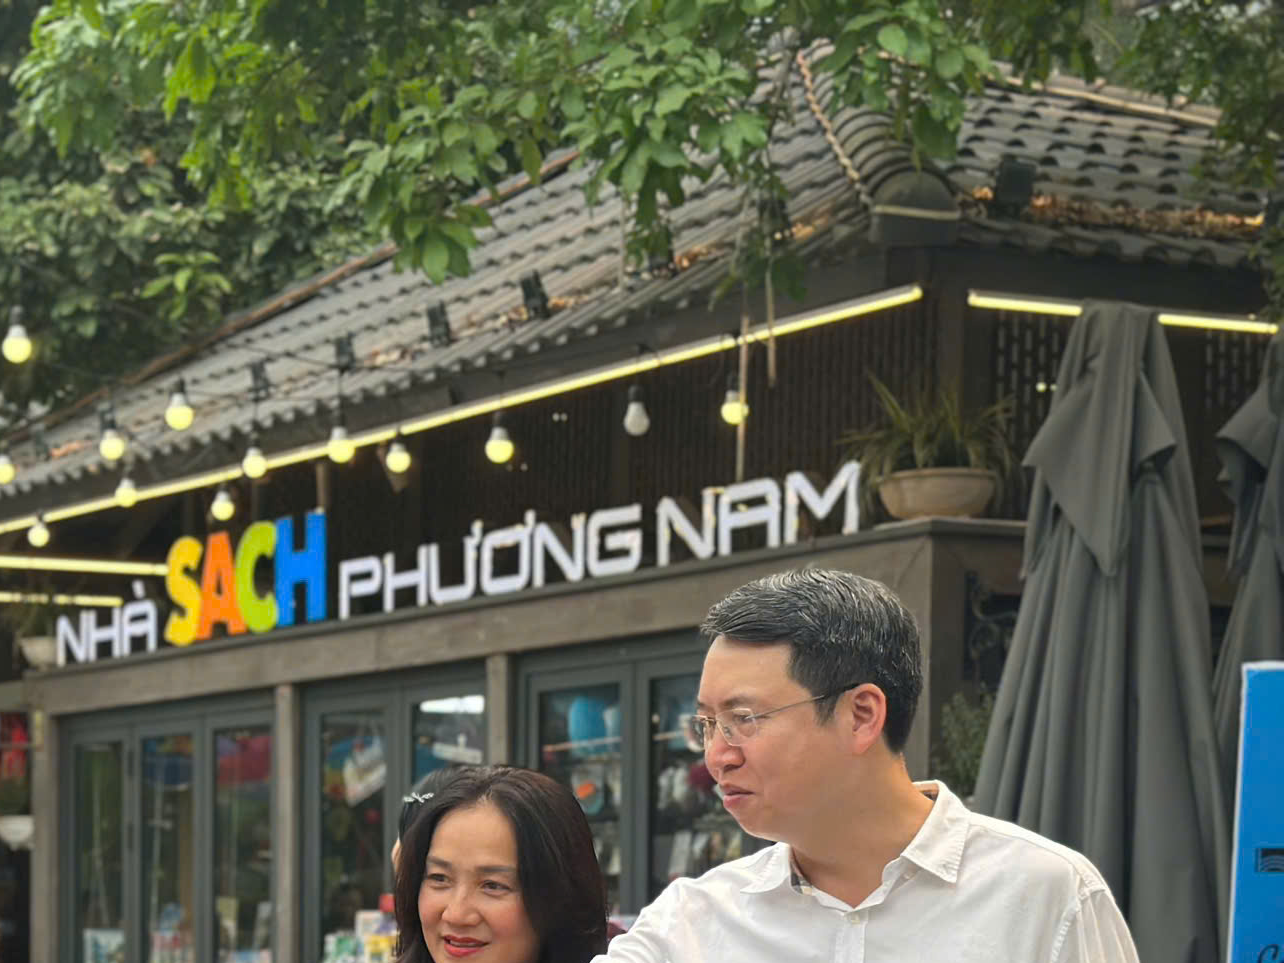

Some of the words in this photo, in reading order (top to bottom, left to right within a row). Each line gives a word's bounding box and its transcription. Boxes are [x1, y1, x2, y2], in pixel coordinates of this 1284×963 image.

[56, 580, 157, 667] NHÀ
[338, 503, 641, 621] PHƯƠNG
[656, 460, 861, 567] NAM
